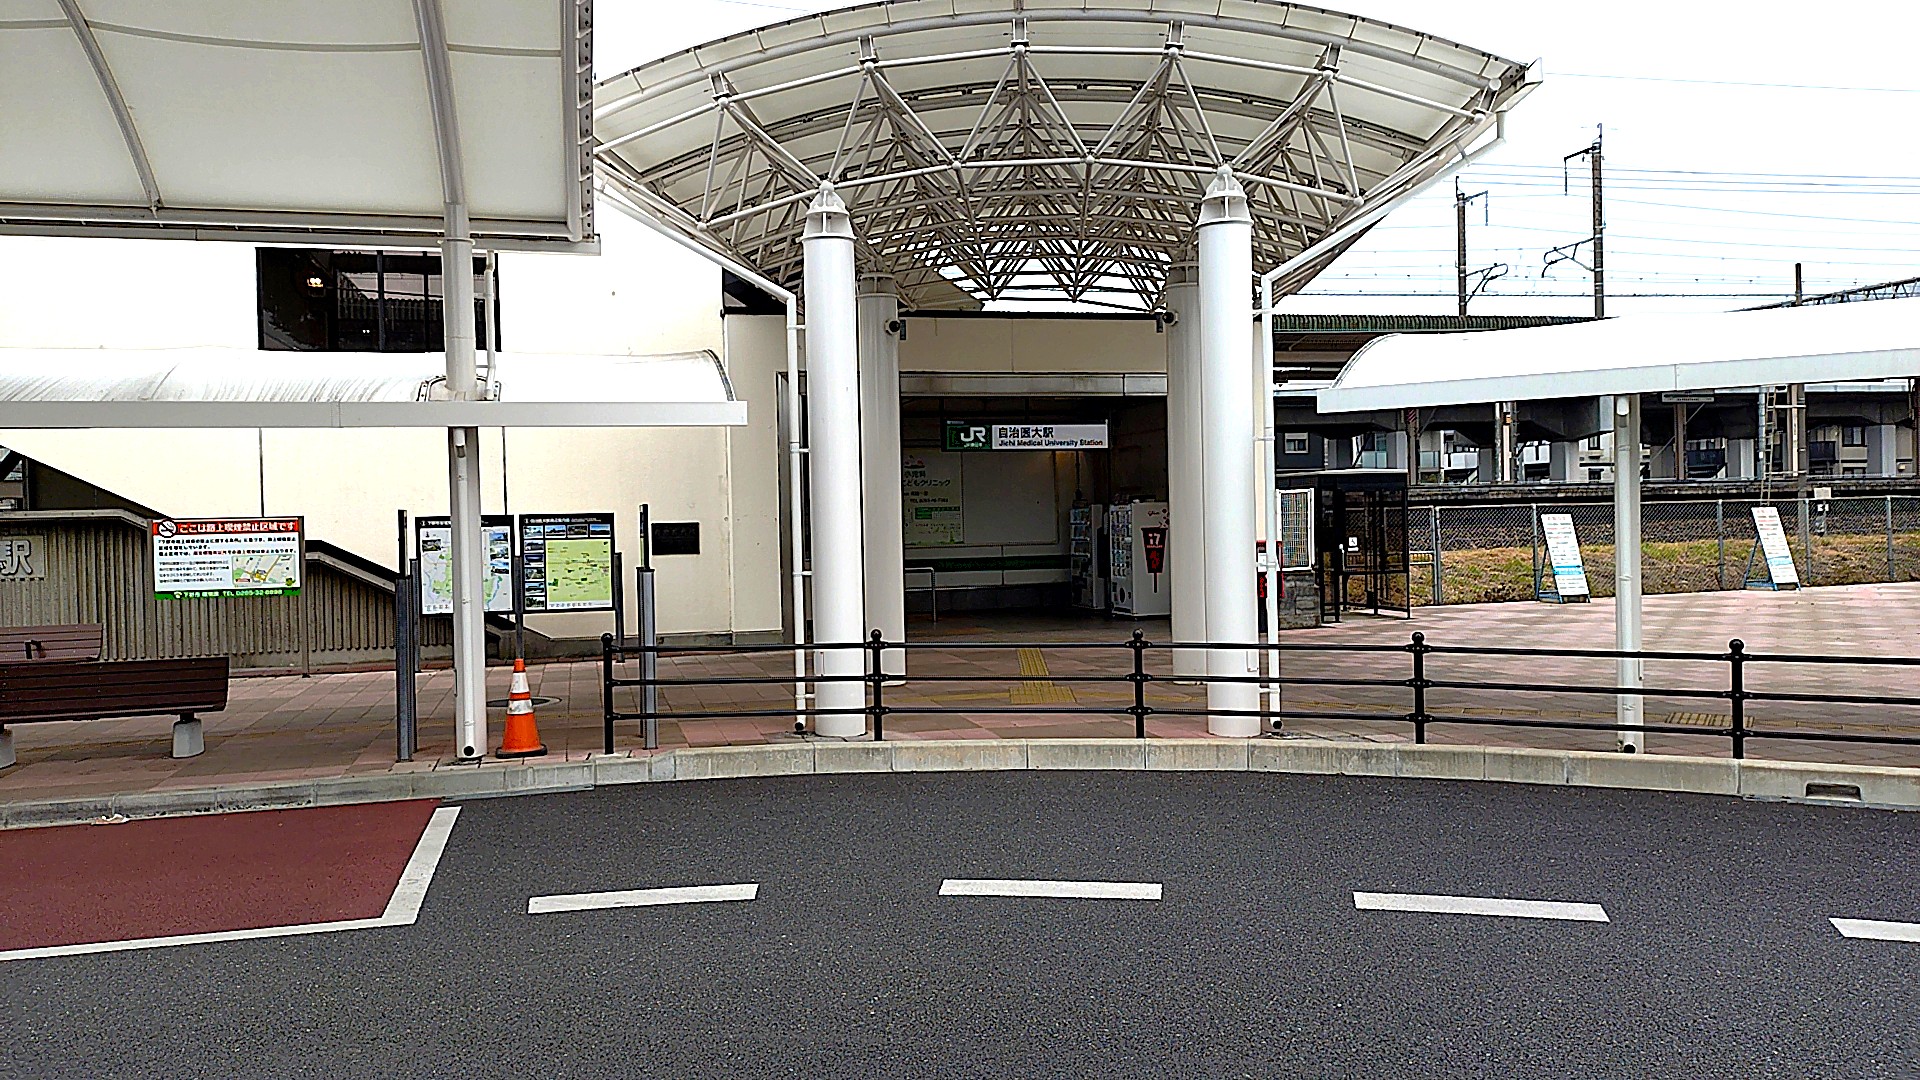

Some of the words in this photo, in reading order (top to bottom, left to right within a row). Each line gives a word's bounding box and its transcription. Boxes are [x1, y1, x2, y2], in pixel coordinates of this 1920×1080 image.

[960, 426, 986, 442] JR
[998, 426, 1054, 439] 自治医大駅
[998, 439, 1016, 447] Jichi
[1017, 439, 1043, 447] Medical
[1044, 439, 1078, 448] University
[1079, 439, 1103, 447] Station
